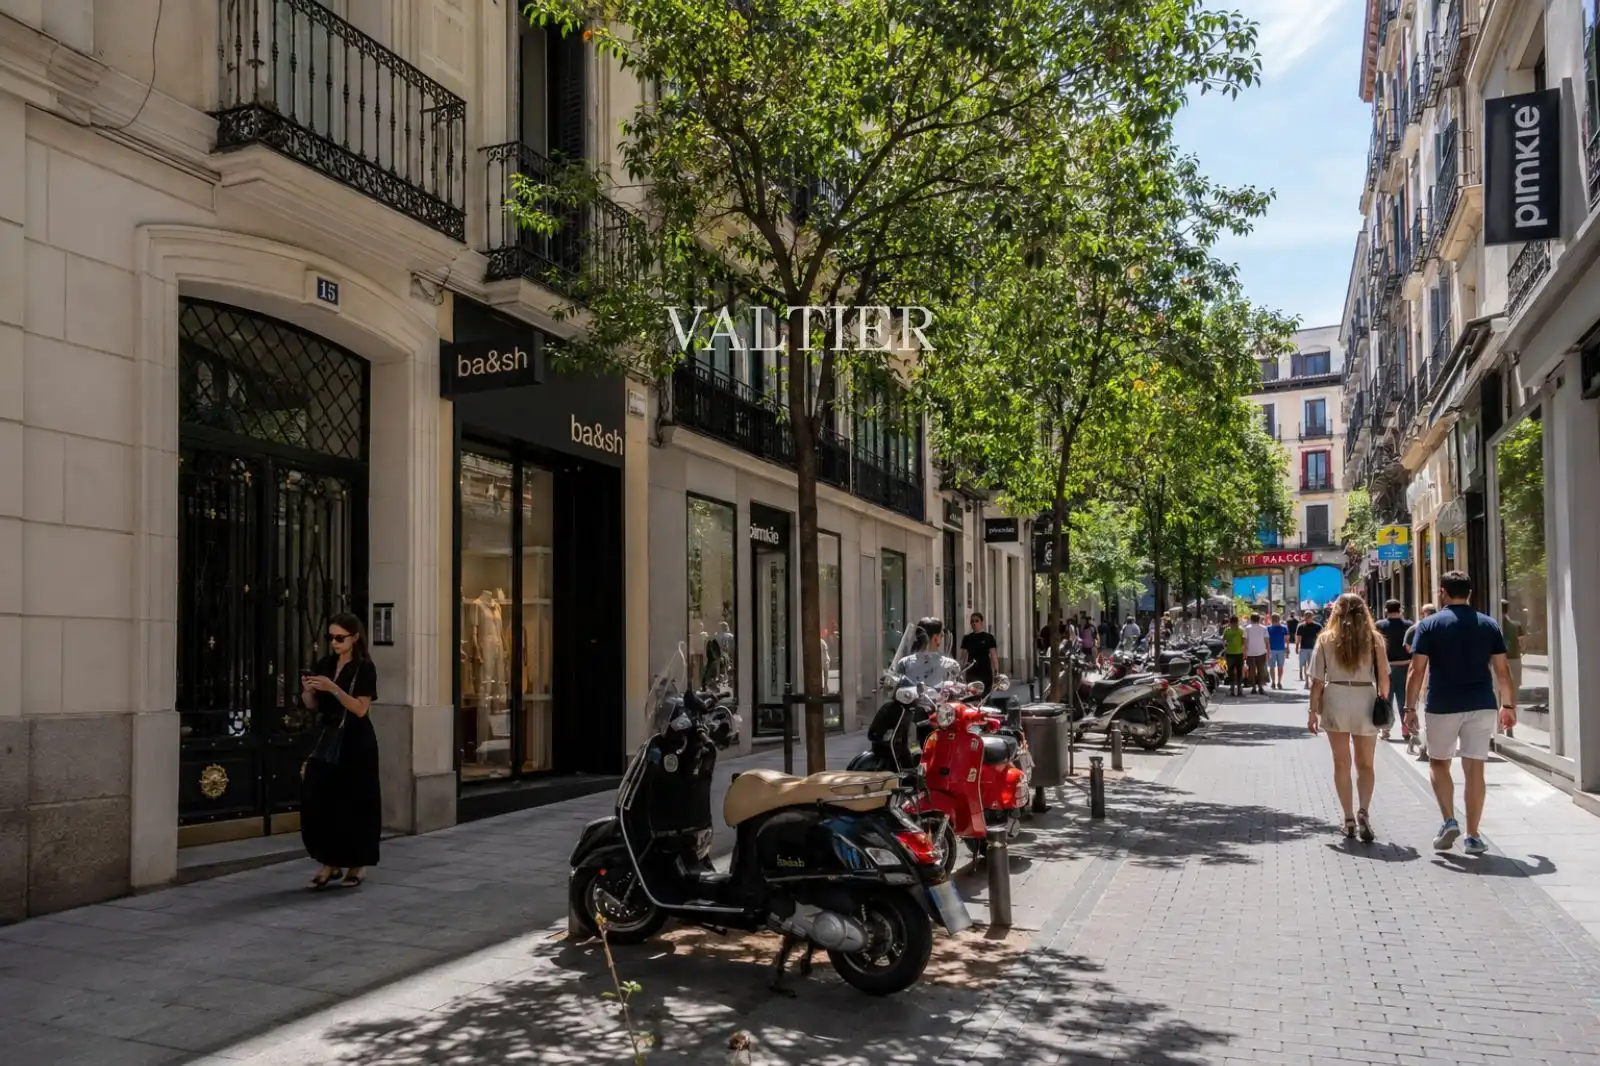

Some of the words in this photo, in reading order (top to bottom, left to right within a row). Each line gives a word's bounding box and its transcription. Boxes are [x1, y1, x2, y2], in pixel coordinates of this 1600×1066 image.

[1511, 103, 1548, 228] pimkie
[320, 281, 336, 301] 15
[457, 346, 528, 377] ba&sh
[570, 413, 623, 456] ba&sh
